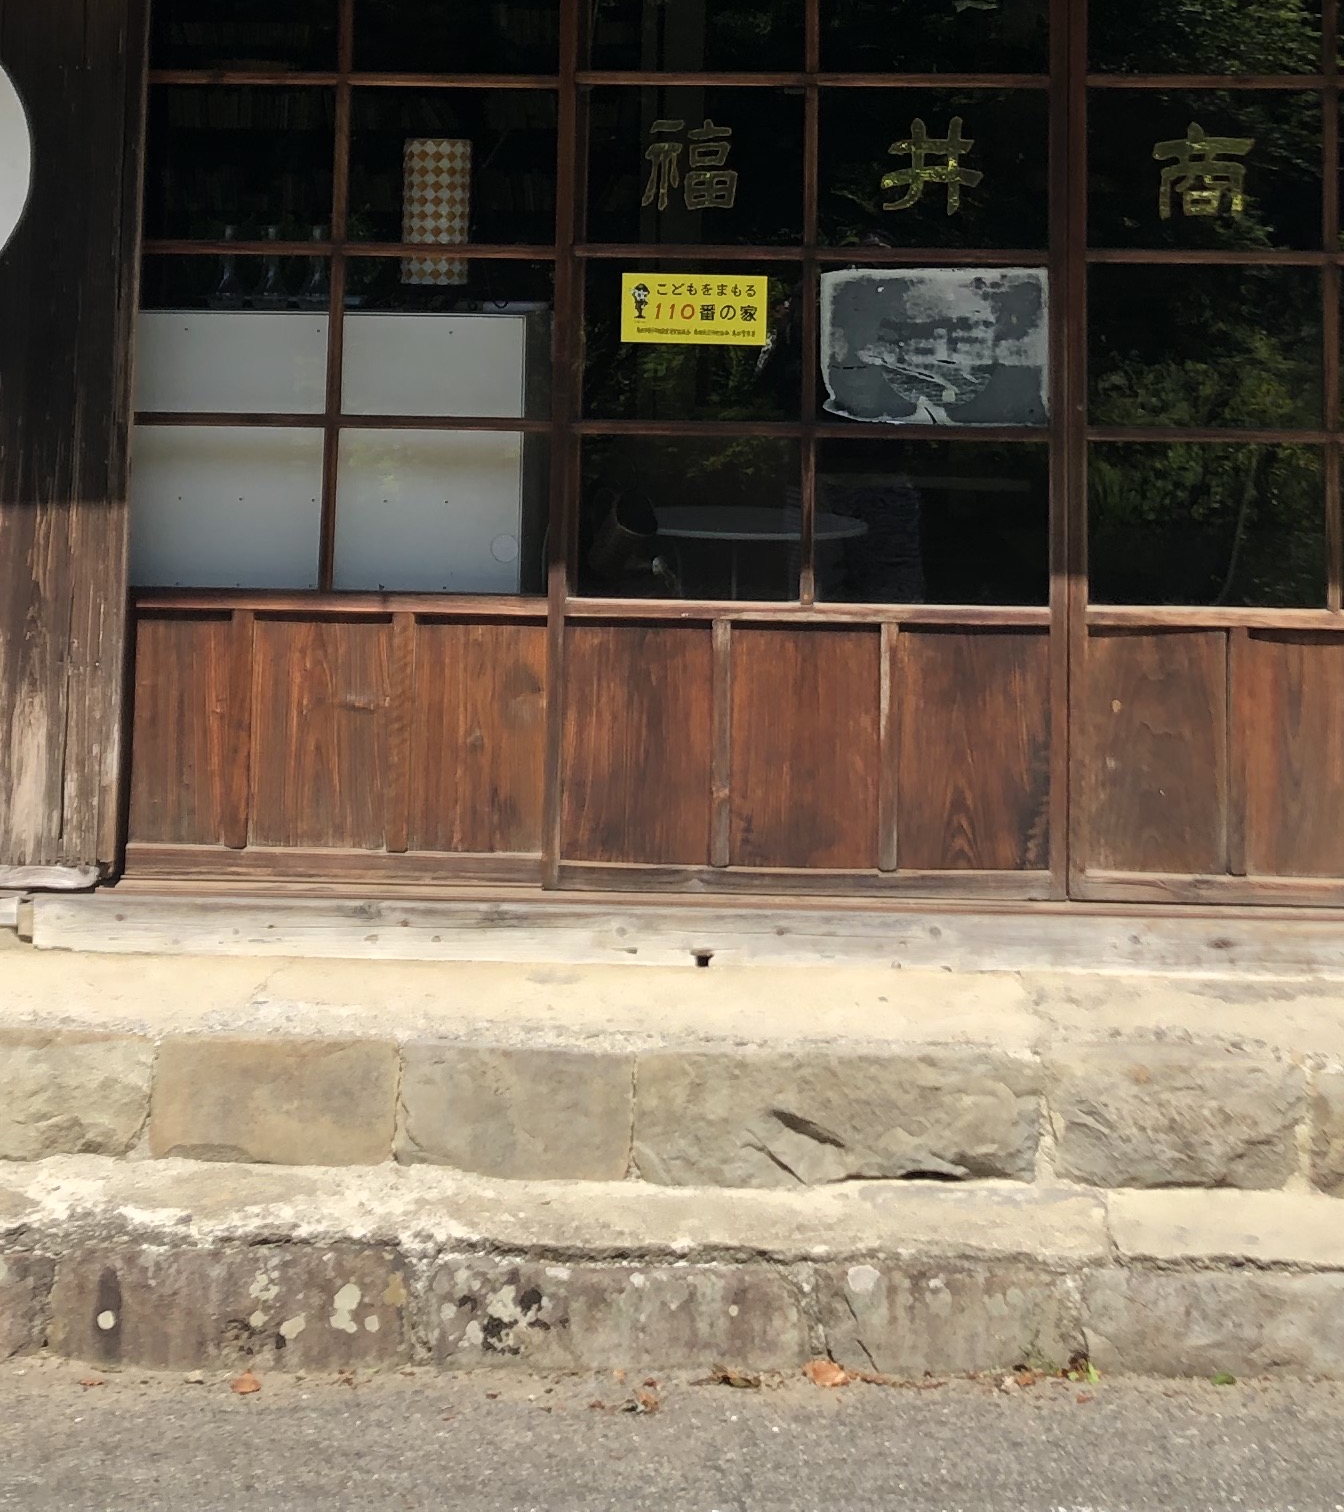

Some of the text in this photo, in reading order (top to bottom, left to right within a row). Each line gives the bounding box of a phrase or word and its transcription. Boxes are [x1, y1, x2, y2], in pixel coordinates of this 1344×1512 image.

[657, 283, 757, 298] こどもをまもる
[654, 302, 758, 322] 110番の家
